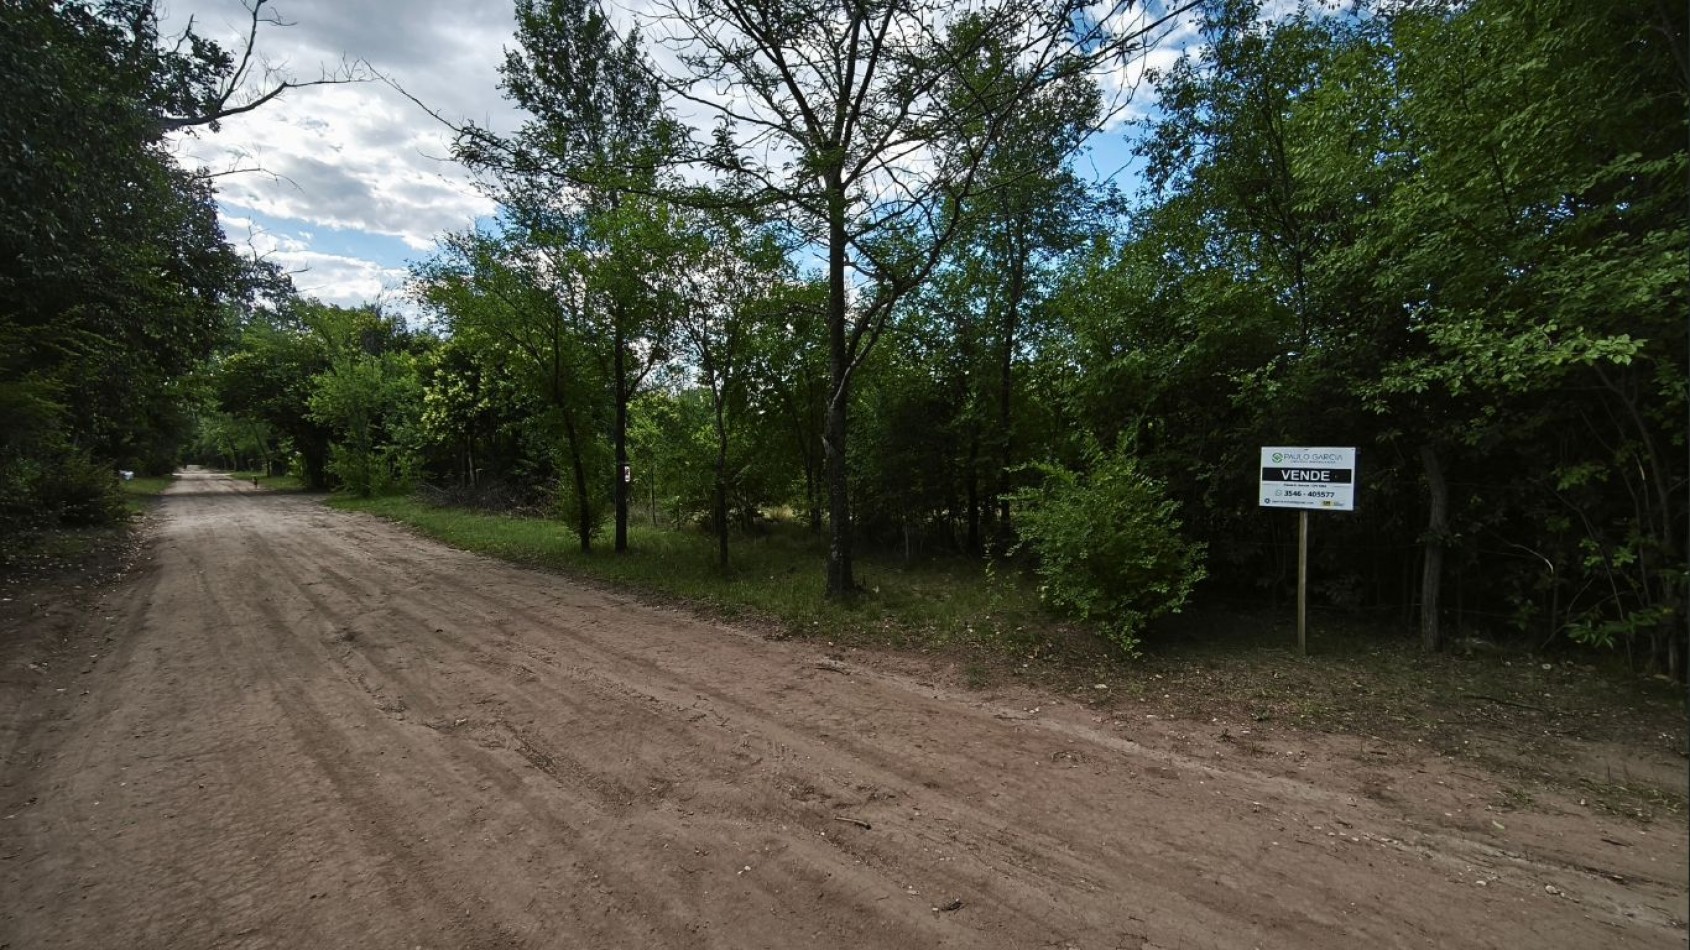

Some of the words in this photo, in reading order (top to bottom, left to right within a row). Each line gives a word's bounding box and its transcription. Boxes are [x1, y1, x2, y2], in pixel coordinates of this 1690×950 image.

[1283, 453, 1310, 461] PAULO
[1312, 453, 1343, 461] GARCIA
[1281, 469, 1331, 481] VENDE
